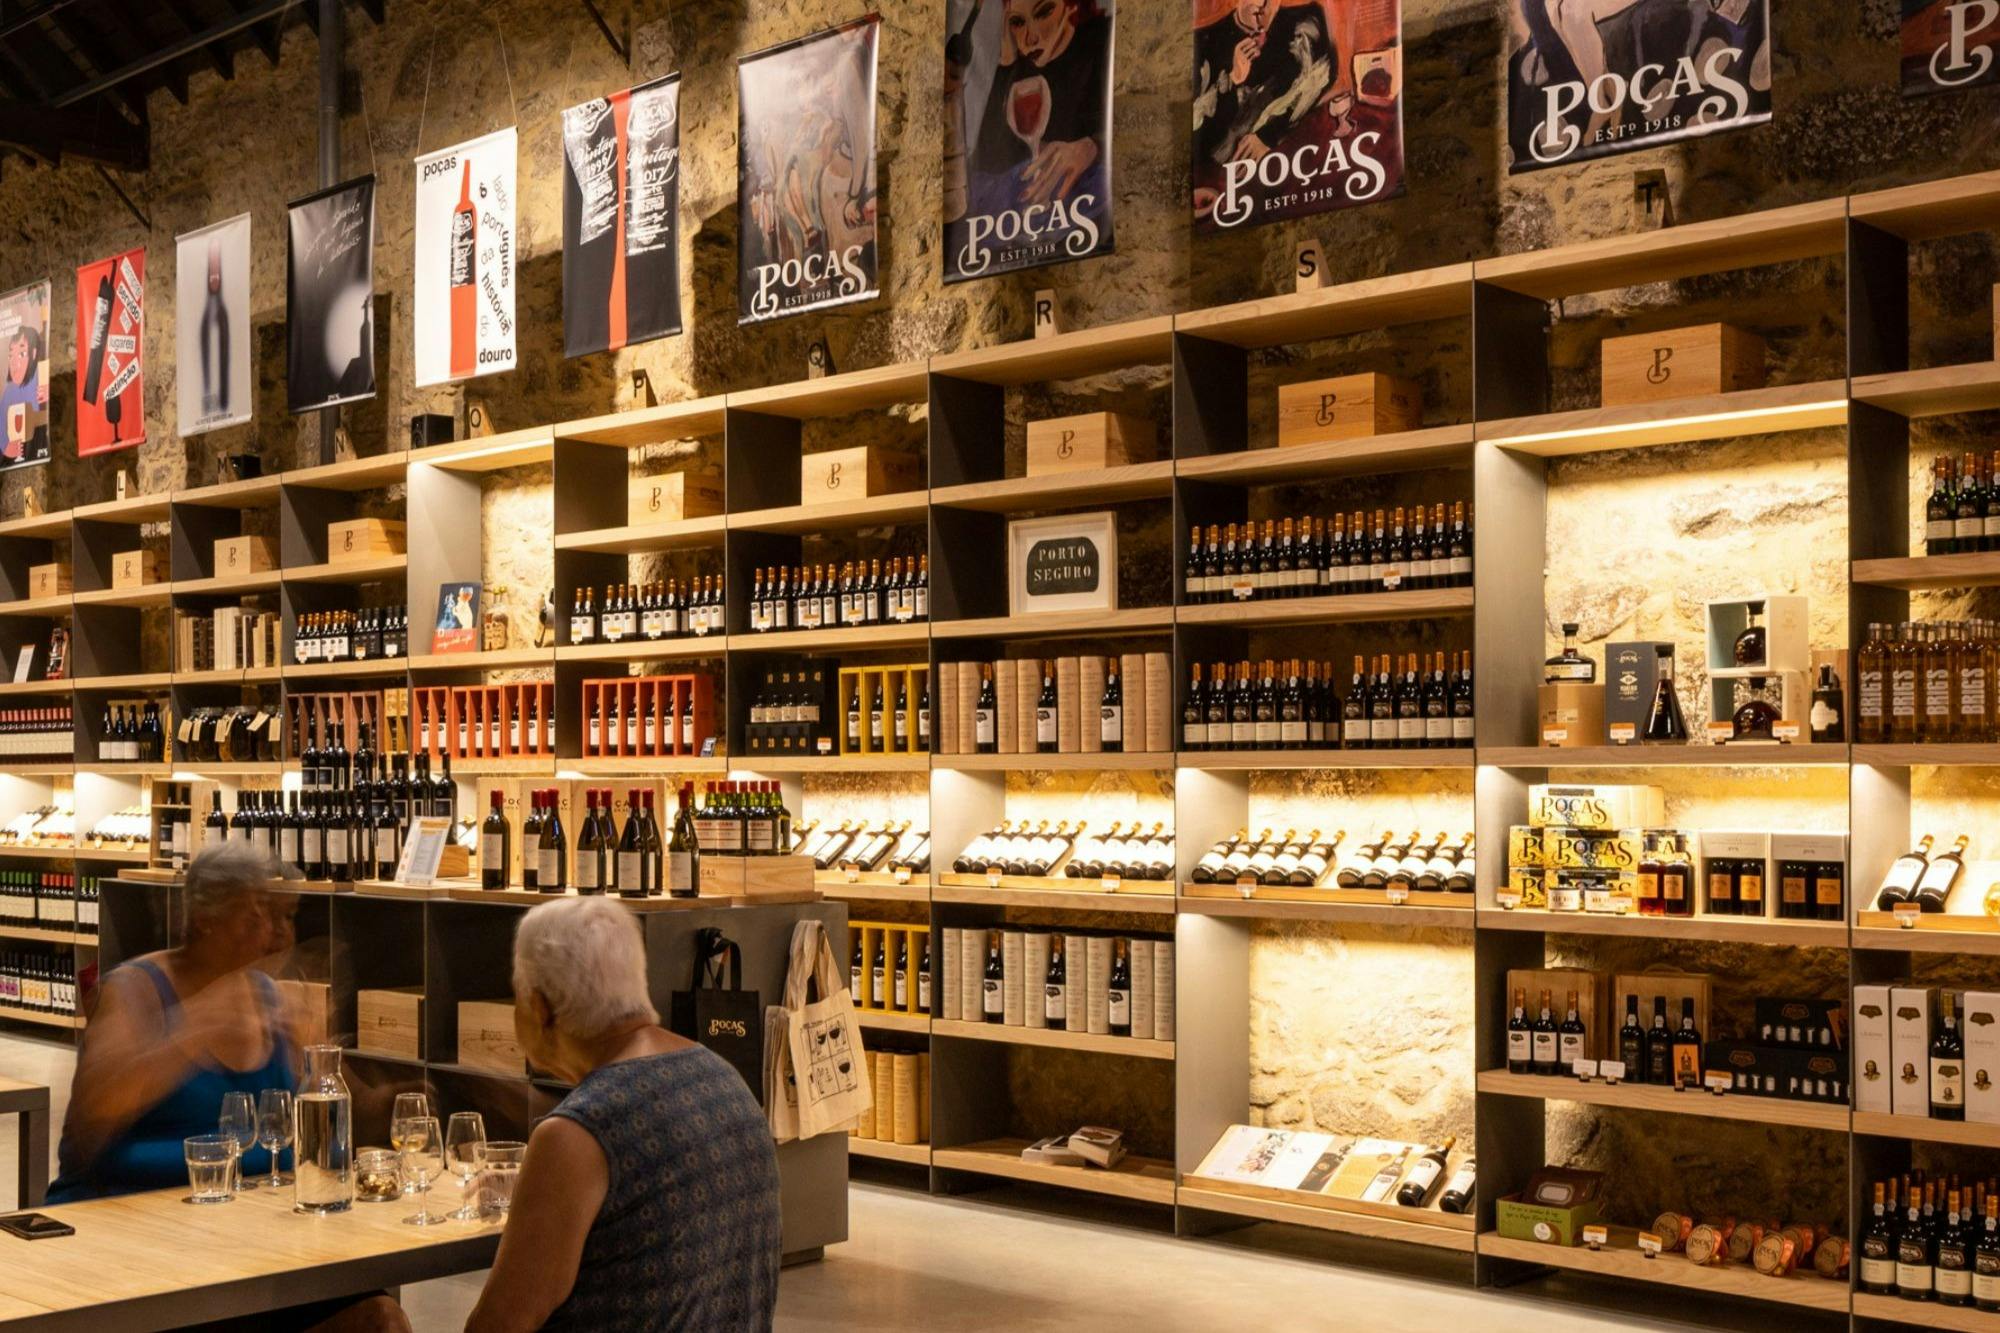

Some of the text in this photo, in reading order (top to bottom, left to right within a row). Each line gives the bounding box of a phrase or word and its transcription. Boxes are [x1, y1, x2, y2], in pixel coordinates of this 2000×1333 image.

[1529, 48, 1748, 163] POÇAS
[1644, 115, 1682, 133] 1918
[424, 156, 457, 181] poças
[1213, 131, 1385, 227] POÇAS
[1304, 187, 1333, 202] 1918
[1638, 181, 1659, 213] T
[958, 194, 1099, 276] POÇAS
[1032, 243, 1056, 257] 1918
[1299, 250, 1316, 278] S
[751, 245, 867, 320] POÇAS
[811, 288, 831, 301] 1918
[1036, 300, 1051, 326] R
[479, 347, 512, 364] douro
[105, 363, 138, 400] distinção
[634, 376, 646, 398] P
[471, 408, 481, 428] O
[336, 434, 345, 454] N
[218, 457, 227, 472] M
[118, 476, 124, 491] L
[1039, 545, 1086, 562] PORTO
[1034, 565, 1091, 583] SEGURO
[709, 1019, 746, 1037] POÇAS
